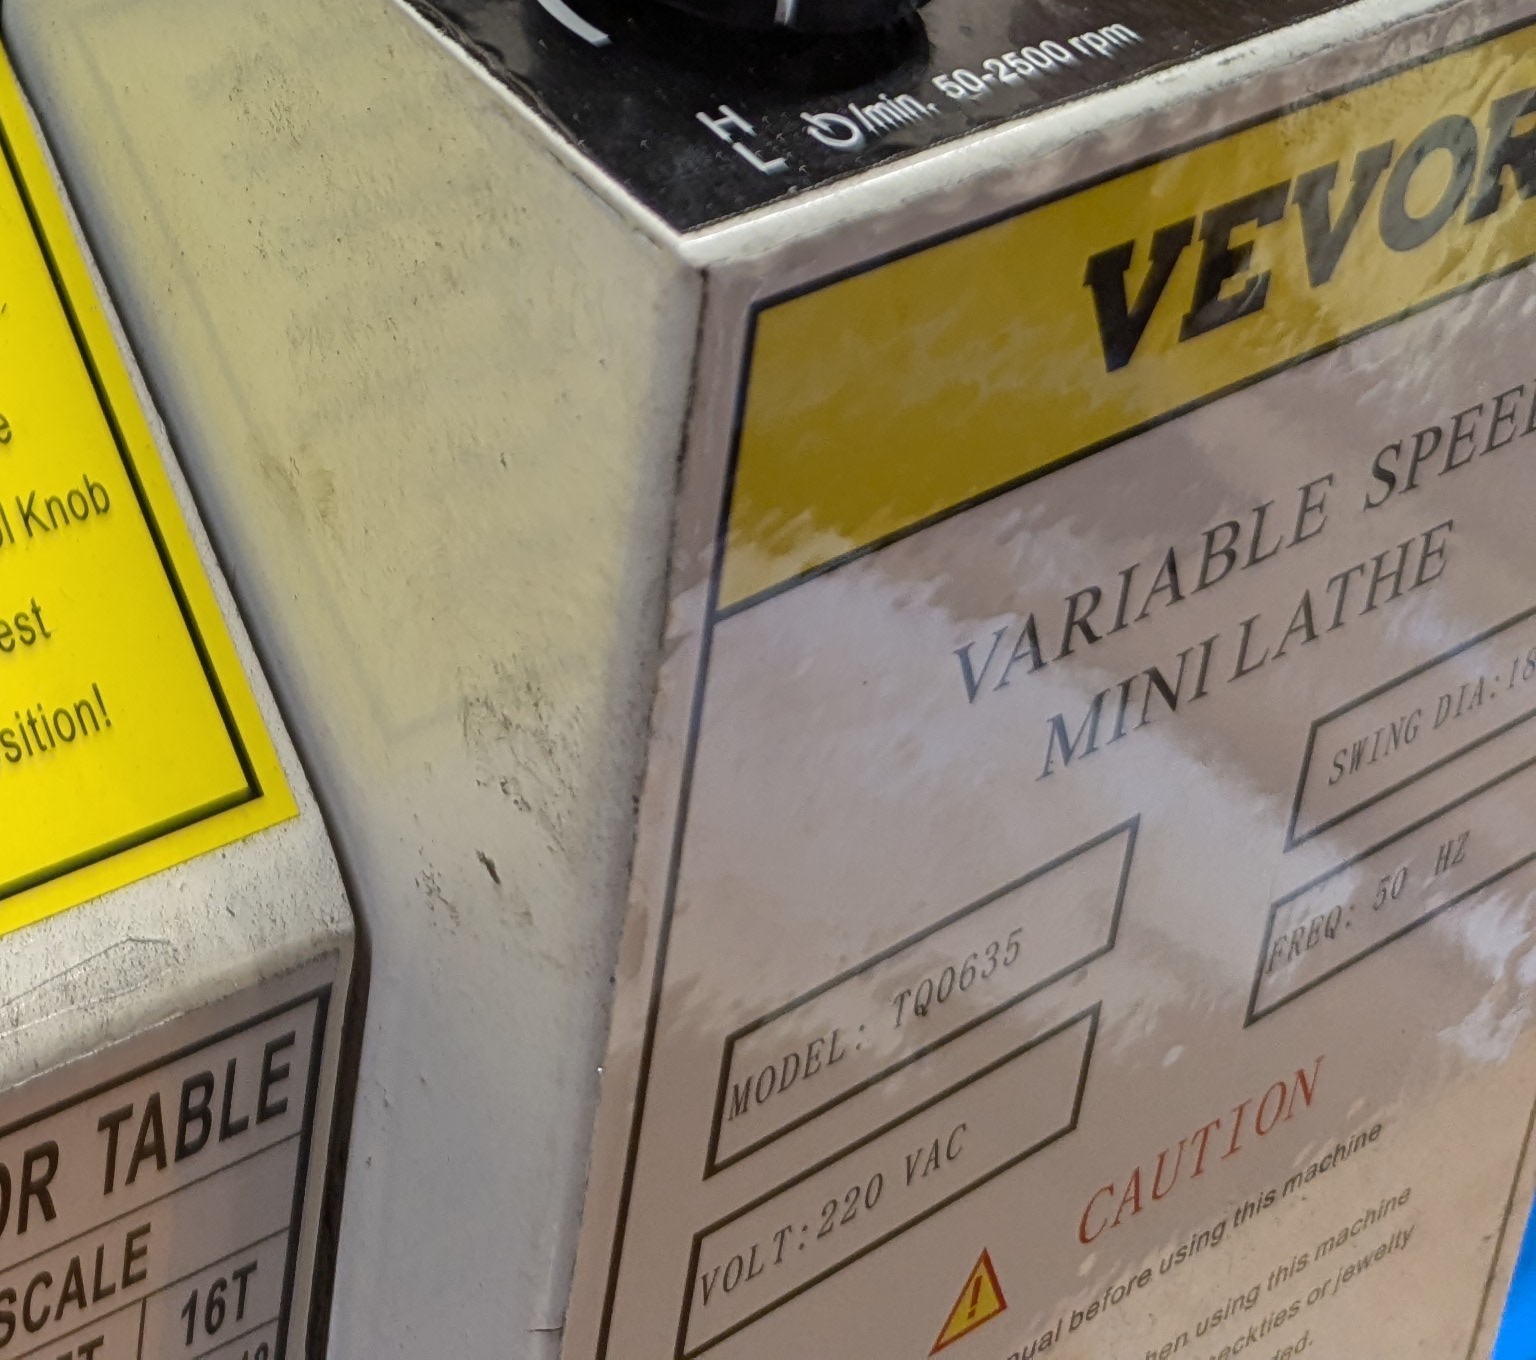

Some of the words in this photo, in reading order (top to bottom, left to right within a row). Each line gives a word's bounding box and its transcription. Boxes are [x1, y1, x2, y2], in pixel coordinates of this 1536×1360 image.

[931, 39, 1071, 100] 50-2500
[1068, 22, 1146, 60] rpm
[695, 104, 757, 143] H
[731, 141, 789, 176] L
[1083, 86, 1536, 374] VEVOR
[15, 474, 111, 540] Knob
[951, 472, 1335, 706] VARIABLE
[1363, 378, 1536, 511] SPEE
[1328, 708, 1423, 786] SWING
[1265, 904, 1355, 973] FREQ:
[1372, 866, 1409, 912] 50
[1434, 829, 1471, 877] HZ
[97, 1030, 297, 1197] TABLE
[726, 1023, 866, 1122] MODEL:
[903, 1122, 968, 1188] VAC
[1077, 1055, 1326, 1246] CAUTION
[1067, 1264, 1154, 1334] before
[1158, 1217, 1227, 1277] using
[1233, 1186, 1276, 1230] this
[1281, 1121, 1384, 1199] machine
[1194, 1283, 1262, 1339] using
[1266, 1251, 1311, 1296] this
[1313, 1184, 1413, 1264] machine
[180, 1259, 259, 1347] 16T
[1210, 1298, 1302, 1360] eckties
[1307, 1277, 1332, 1307] or
